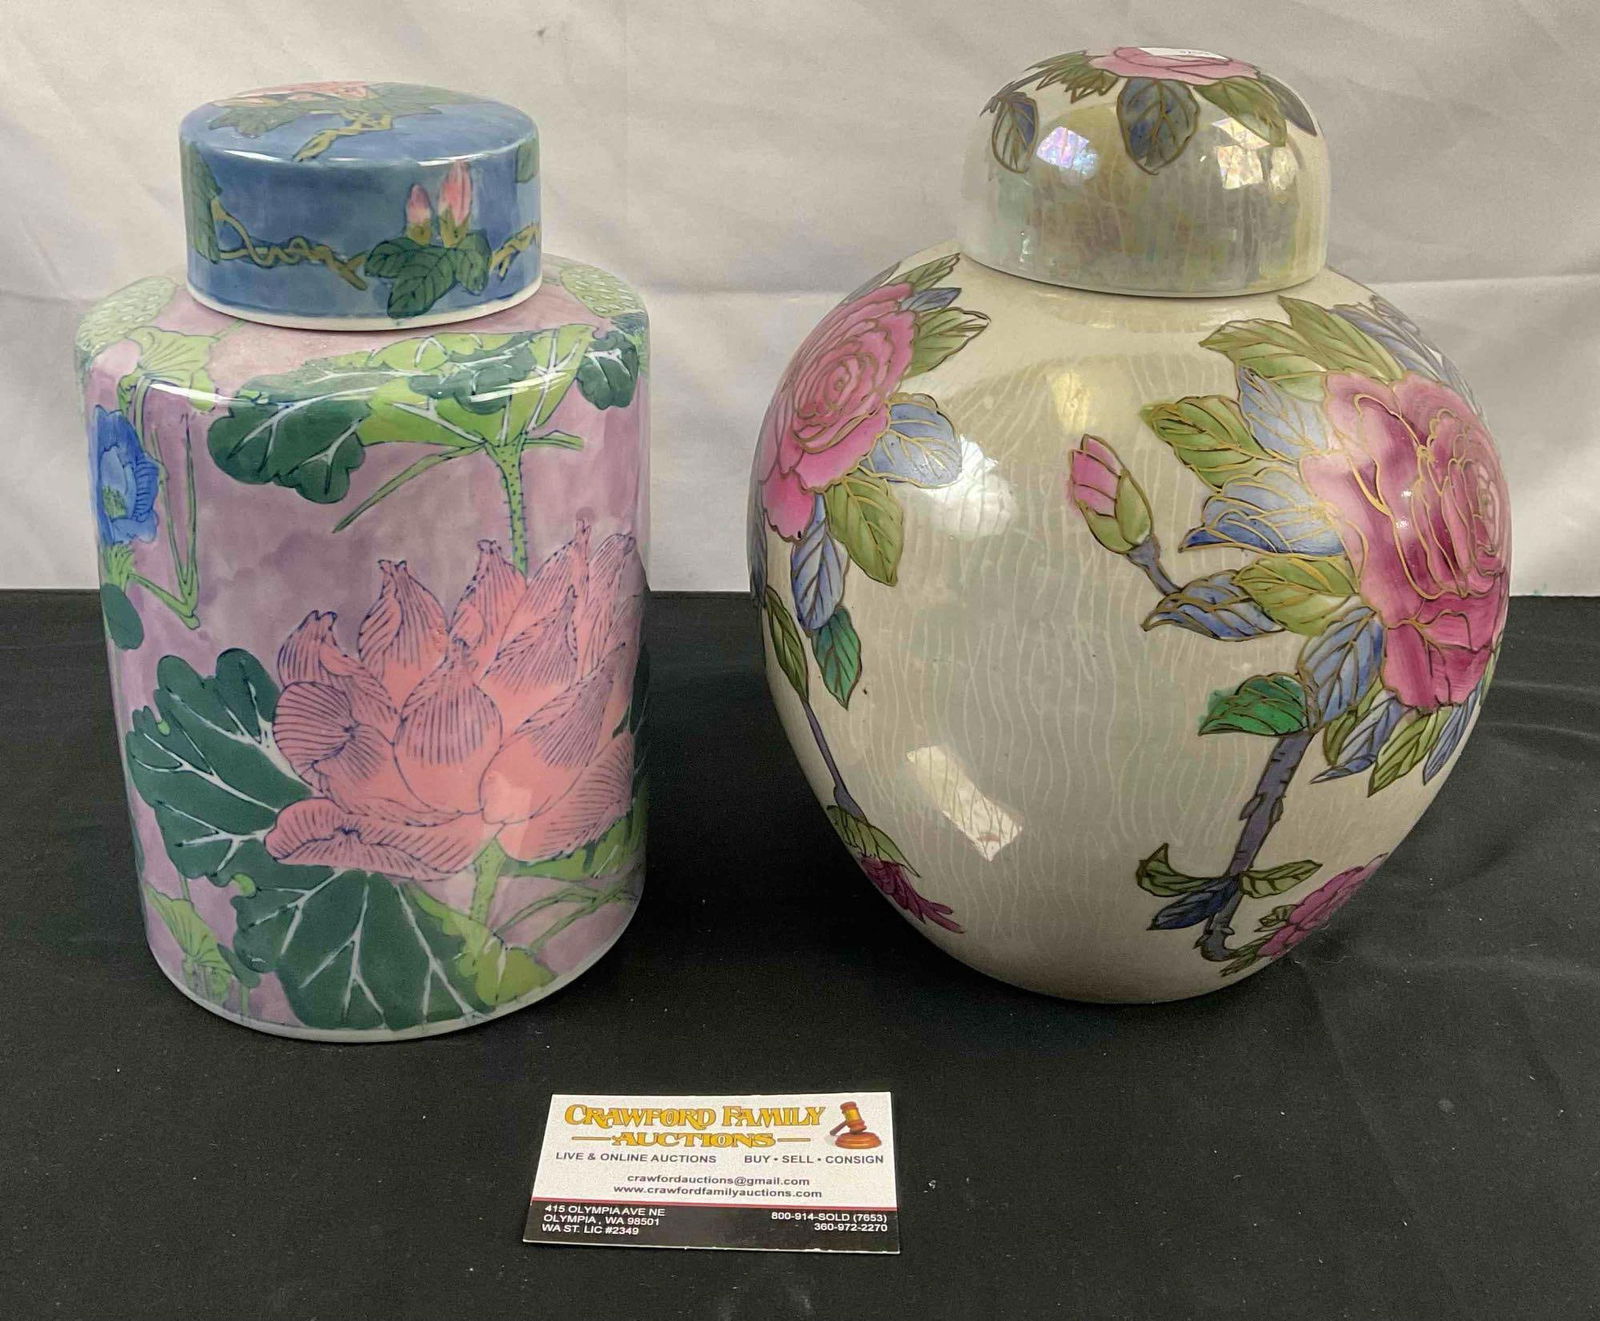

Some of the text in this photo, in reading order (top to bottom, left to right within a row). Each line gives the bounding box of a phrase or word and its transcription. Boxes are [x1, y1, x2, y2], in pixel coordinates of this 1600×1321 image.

[564, 1104, 826, 1131] CRAWFORD FAMILY
[611, 1132, 776, 1148] AUCTIONS
[555, 1152, 717, 1163] LIVE & ONLINE AUCTIONS
[744, 1155, 884, 1164] BUY SELL CONSIGN
[627, 1174, 810, 1186] crawfordauctions@gmail.com
[613, 1185, 823, 1198] www.crawfordfamilyauctions.com
[545, 1205, 666, 1217] 415 OLYMPIA AVE NE
[605, 1216, 625, 1225] WA
[627, 1217, 660, 1226] 98501
[771, 1212, 888, 1223] 800-914-SOLD (7653)
[541, 1224, 562, 1232] WA
[584, 1226, 603, 1234] LIC
[605, 1227, 640, 1236] #2349
[814, 1223, 888, 1232] 360-972-2270
